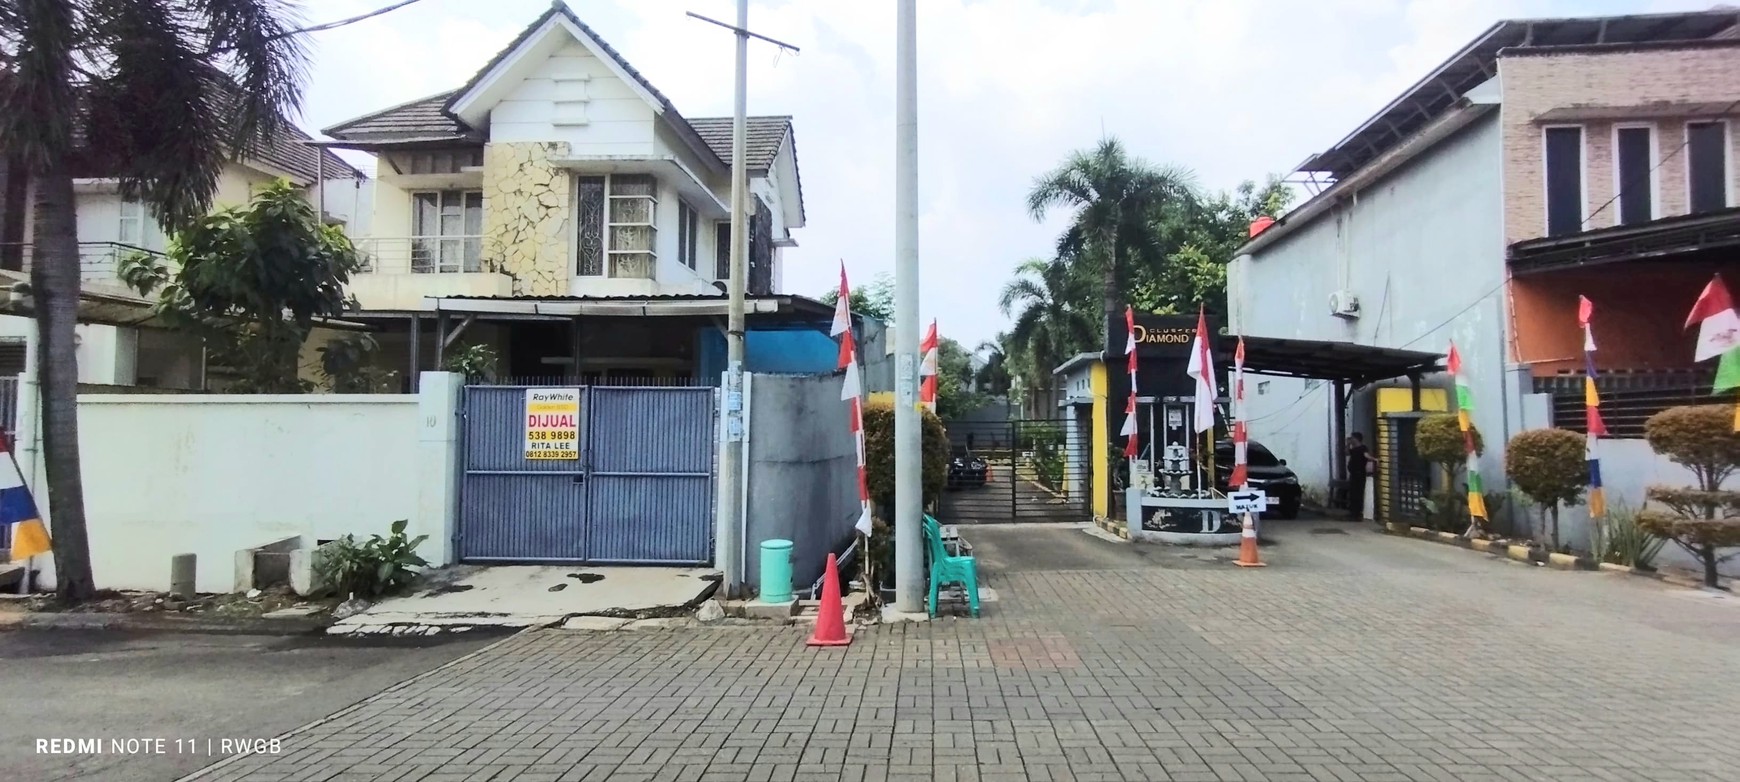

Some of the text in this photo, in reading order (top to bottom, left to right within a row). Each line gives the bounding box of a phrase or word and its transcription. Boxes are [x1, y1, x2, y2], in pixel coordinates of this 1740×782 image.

[1133, 324, 1189, 344] DIAMOND
[528, 414, 576, 428] DIJUAL
[528, 431, 576, 440] 538 9898
[525, 450, 577, 458] 0812 8339 2957
